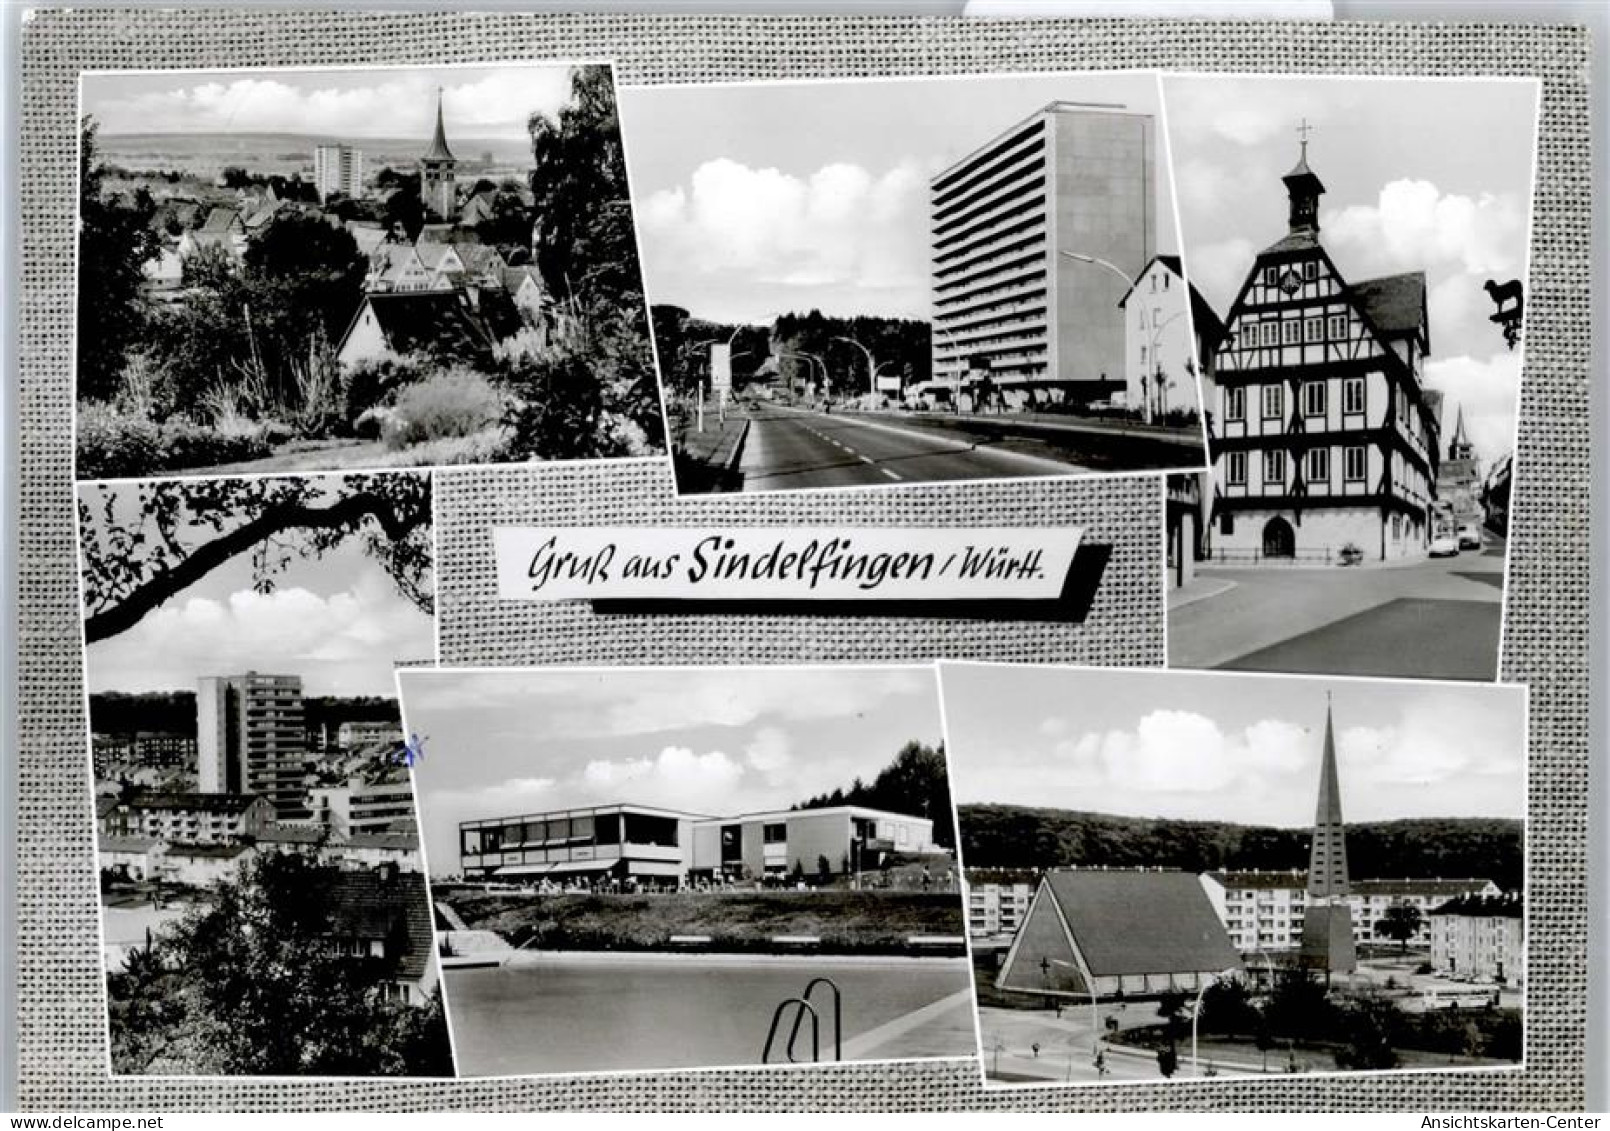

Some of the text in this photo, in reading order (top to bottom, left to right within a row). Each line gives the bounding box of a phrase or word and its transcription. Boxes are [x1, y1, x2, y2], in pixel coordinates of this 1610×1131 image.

[528, 536, 616, 592] Gruß
[622, 554, 681, 580] aus
[687, 535, 935, 590] Sindelfingen
